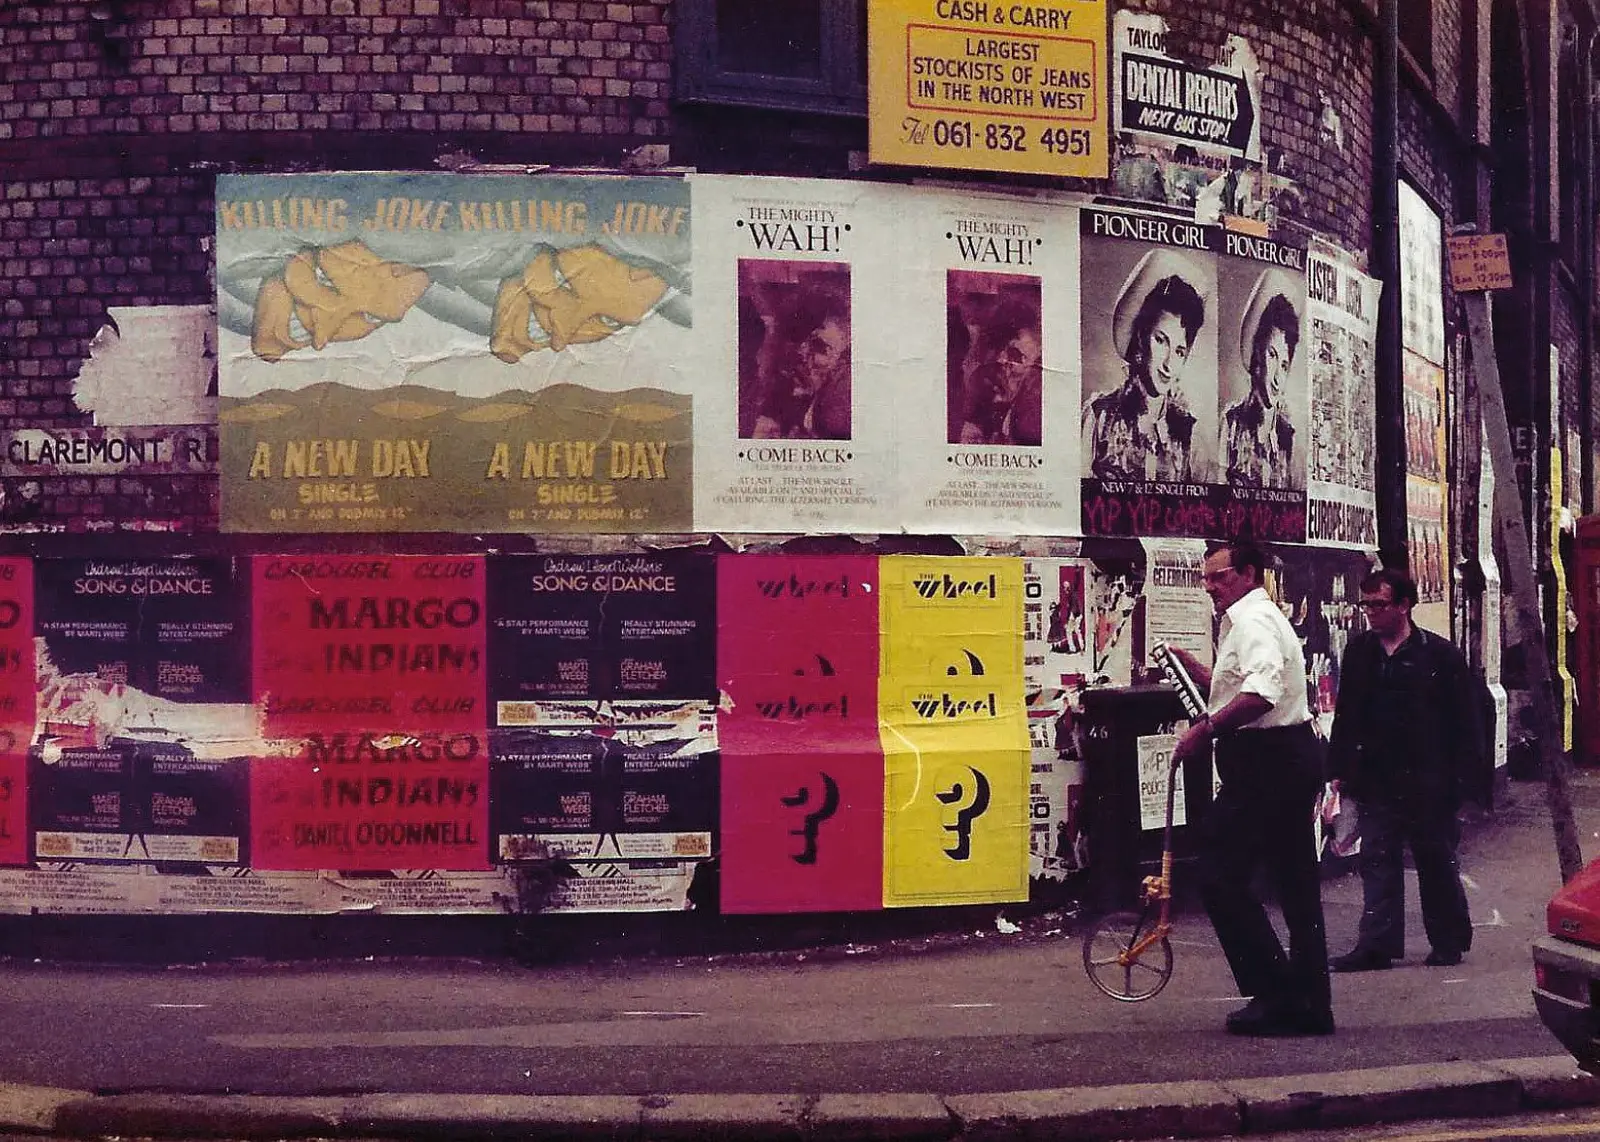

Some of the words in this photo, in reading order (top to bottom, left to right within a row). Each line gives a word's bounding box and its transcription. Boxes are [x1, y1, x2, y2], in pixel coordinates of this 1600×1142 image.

[936, 0, 988, 23] CASH
[993, 7, 1005, 24] &
[1009, 5, 1072, 30] CARRY
[966, 38, 1040, 62] LARGEST
[913, 57, 1004, 82] STOCKISTS
[1012, 66, 1033, 84] OF
[1040, 68, 1091, 89] JEANS
[918, 80, 935, 98] IN
[943, 83, 972, 101] THE
[979, 85, 1034, 107] NORTH
[1040, 91, 1086, 111] WEST
[1127, 60, 1182, 110] DENTAL
[1185, 72, 1239, 121] REPAIRS
[900, 116, 930, 145] Tel
[1040, 128, 1091, 156] 4951
[1138, 107, 1175, 129] NEXT
[1173, 114, 1198, 135] BUS
[1197, 118, 1232, 143] STOP!
[220, 198, 348, 232] KILLING
[360, 197, 452, 232] JOKE
[459, 199, 588, 235] KILLING
[601, 200, 688, 236] JOKE
[780, 207, 837, 223] MIGHTY
[977, 220, 1029, 237] MIGHTY
[748, 222, 842, 253] WAH!
[1093, 213, 1170, 244] PIONEER
[1172, 225, 1210, 250] GIRL
[956, 234, 1033, 266] WAH!
[1226, 234, 1279, 264] PIONEER
[1279, 246, 1303, 270] GIRL
[8, 437, 165, 465] CLAREMONT
[249, 440, 272, 478] A
[283, 439, 360, 478] NEW
[372, 439, 432, 478] DAY
[486, 442, 510, 479] A
[521, 441, 598, 479] NEW
[610, 441, 670, 479] DAY
[746, 447, 799, 463] COME
[802, 448, 847, 463] BACK
[954, 453, 998, 468] COME
[1001, 454, 1037, 469] BACK
[299, 483, 380, 504] SINGLE
[537, 484, 617, 505] SINGLE
[1101, 481, 1125, 493] NEW
[1156, 482, 1184, 497] SINGLE
[1186, 483, 1209, 497] FROM
[74, 578, 127, 595] SONG
[130, 578, 147, 595] &
[149, 578, 213, 595] DANCE
[533, 575, 588, 592] SONG
[592, 575, 610, 592] &
[612, 576, 676, 592] DANCE
[307, 597, 481, 629] MARGO
[1088, 725, 1108, 739] 46
[532, 753, 593, 762] PERFORMANCE
